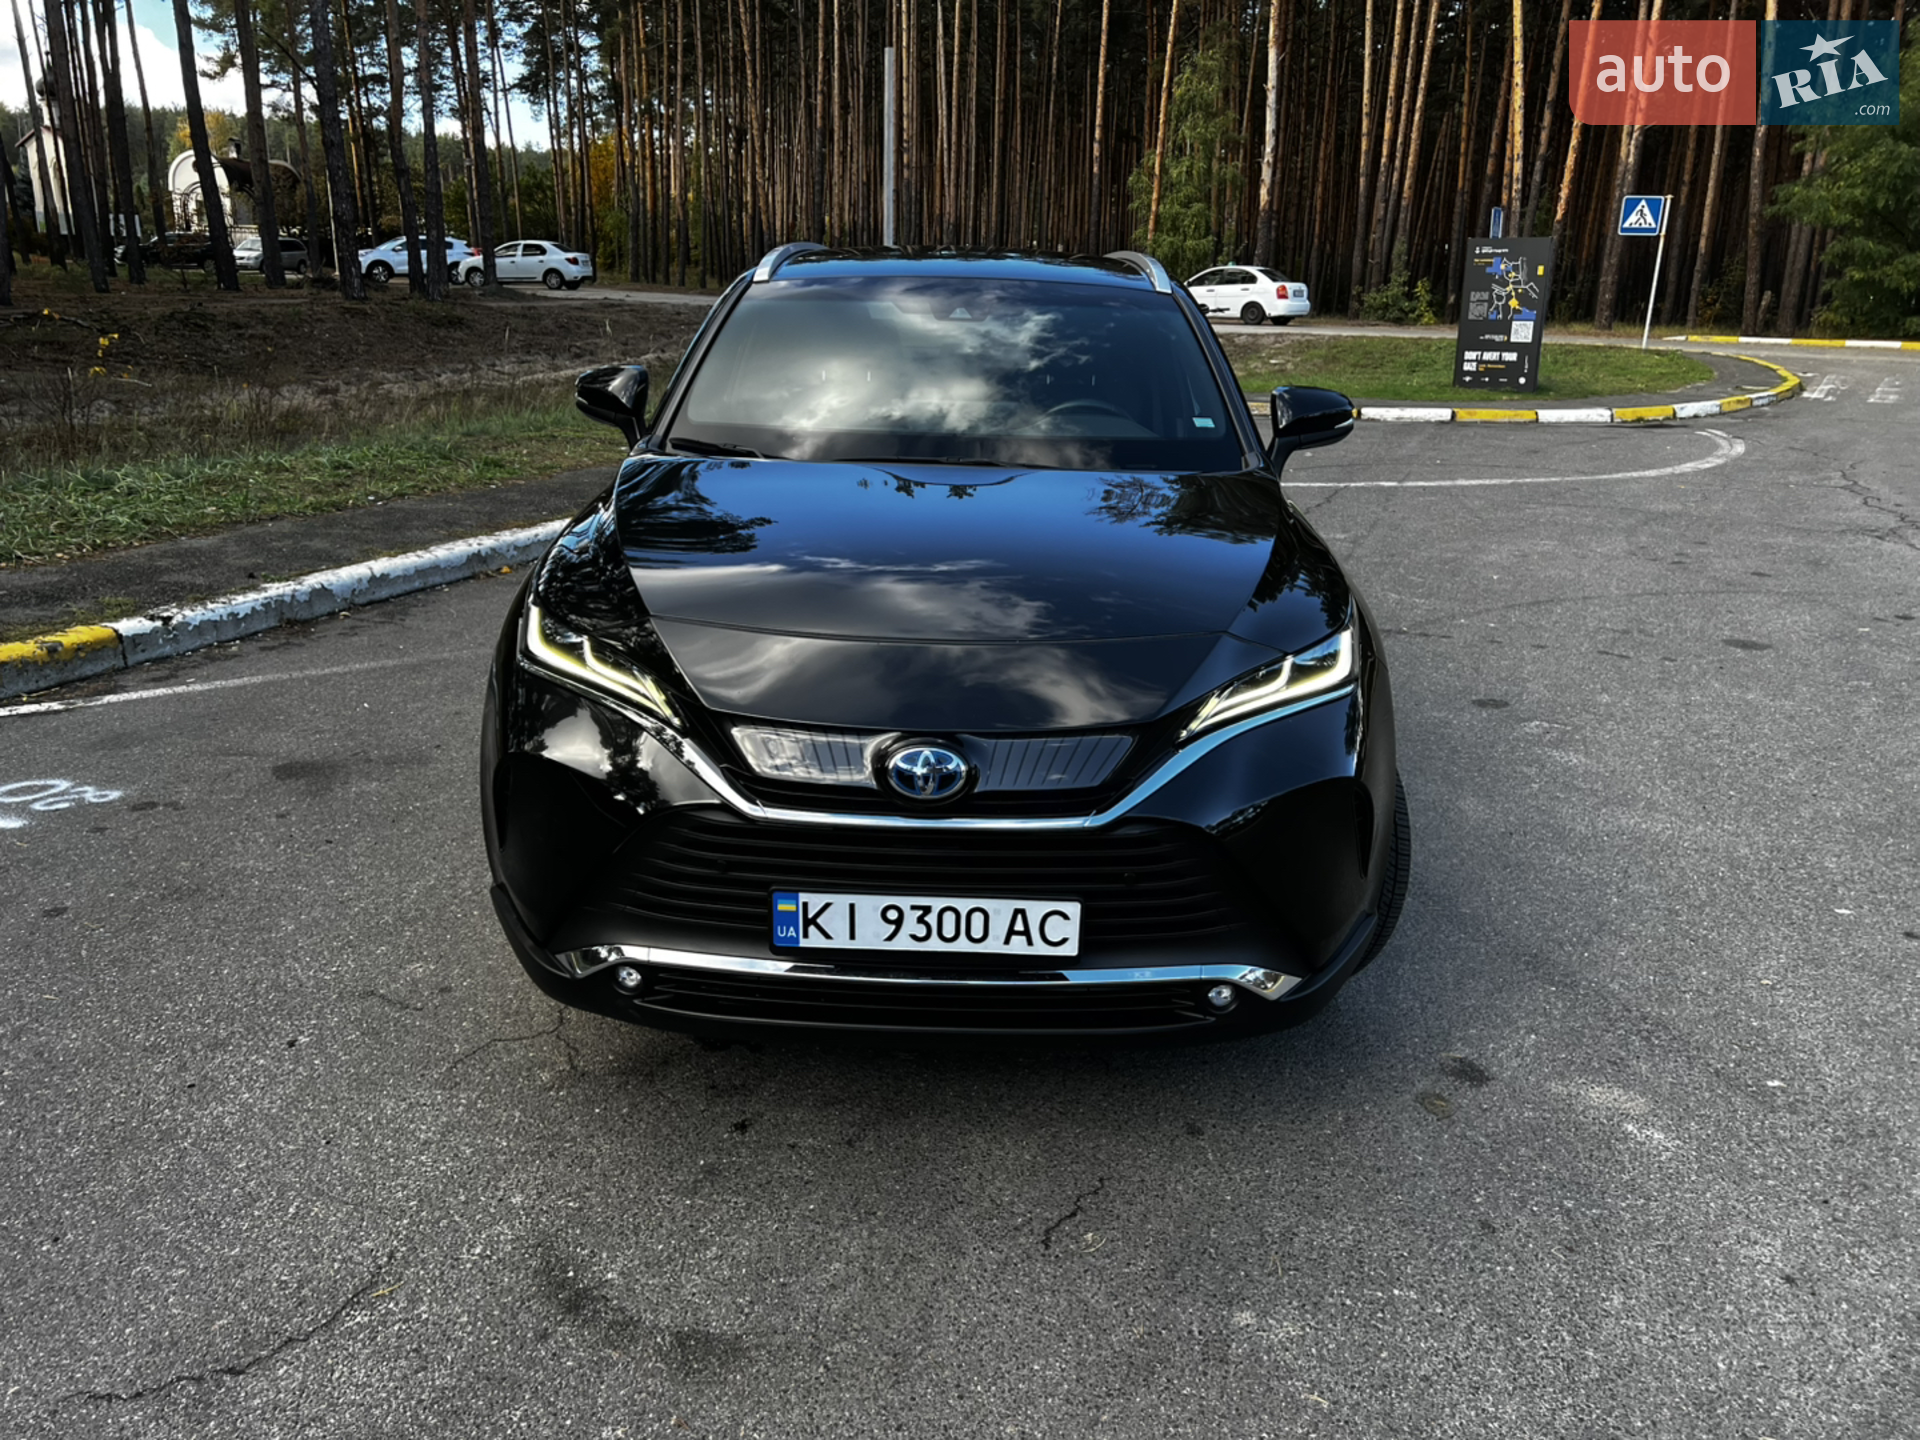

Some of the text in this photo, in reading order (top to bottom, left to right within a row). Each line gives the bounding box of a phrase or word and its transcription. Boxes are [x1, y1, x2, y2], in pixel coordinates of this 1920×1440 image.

[1501, 352, 1518, 362] YOUR
[801, 901, 1072, 947] KI 9300 AC
[777, 925, 797, 938] UA
